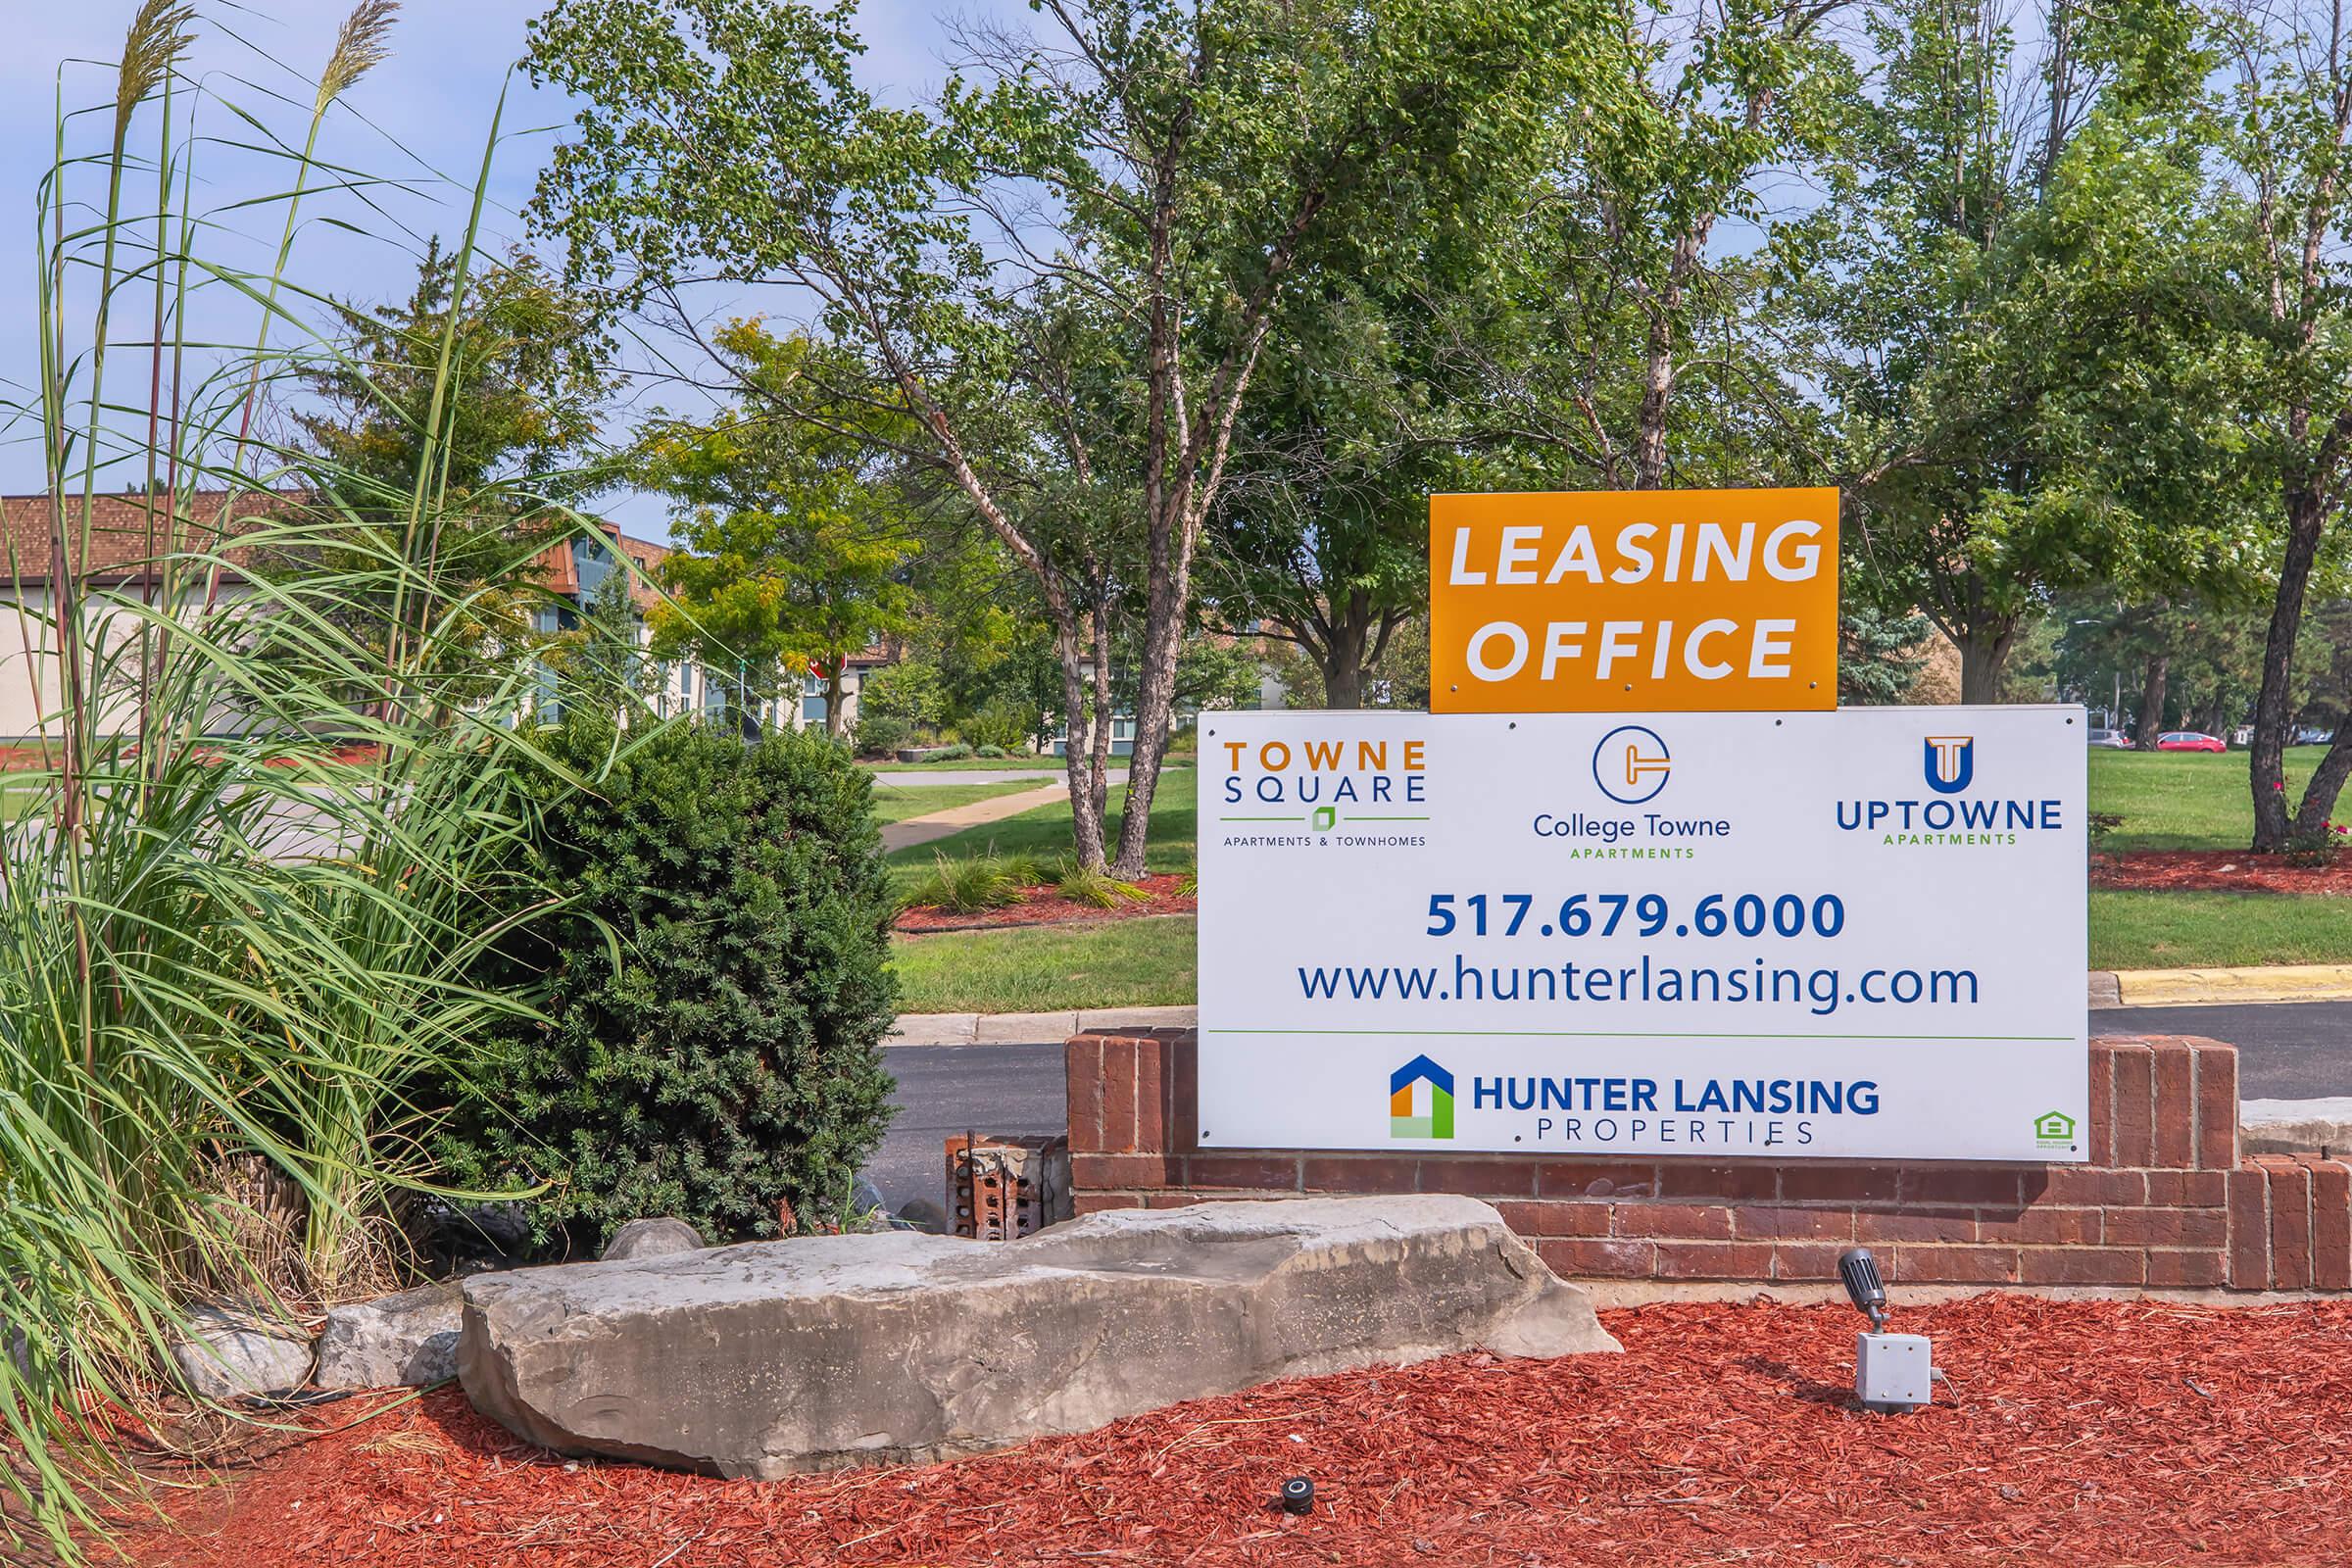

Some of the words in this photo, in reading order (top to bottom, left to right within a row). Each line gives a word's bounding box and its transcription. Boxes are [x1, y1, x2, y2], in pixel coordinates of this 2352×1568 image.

[1450, 520, 1822, 585] LEASING
[1467, 619, 1795, 681] OFFICE
[1224, 741, 1425, 770] TOWNE
[1225, 776, 1425, 803] SQUARE
[1534, 813, 1635, 843] College
[1643, 814, 1730, 836] Towne
[1838, 800, 2062, 830] UPTOWNE
[1223, 836, 1311, 847] APARTMENTS
[1319, 836, 1328, 847] &
[1336, 836, 1426, 847] TOWNHOMES
[1570, 848, 1694, 859] APARTMENTS
[1883, 833, 2016, 846] APARTMENTS
[1427, 894, 1844, 937] 517.679.6000
[1298, 955, 1978, 1015] www.hunterlansing.com
[1474, 1077, 1657, 1111] HUNTER
[1675, 1079, 1879, 1115] LANSING
[1539, 1118, 1812, 1145] PROPERTIES
